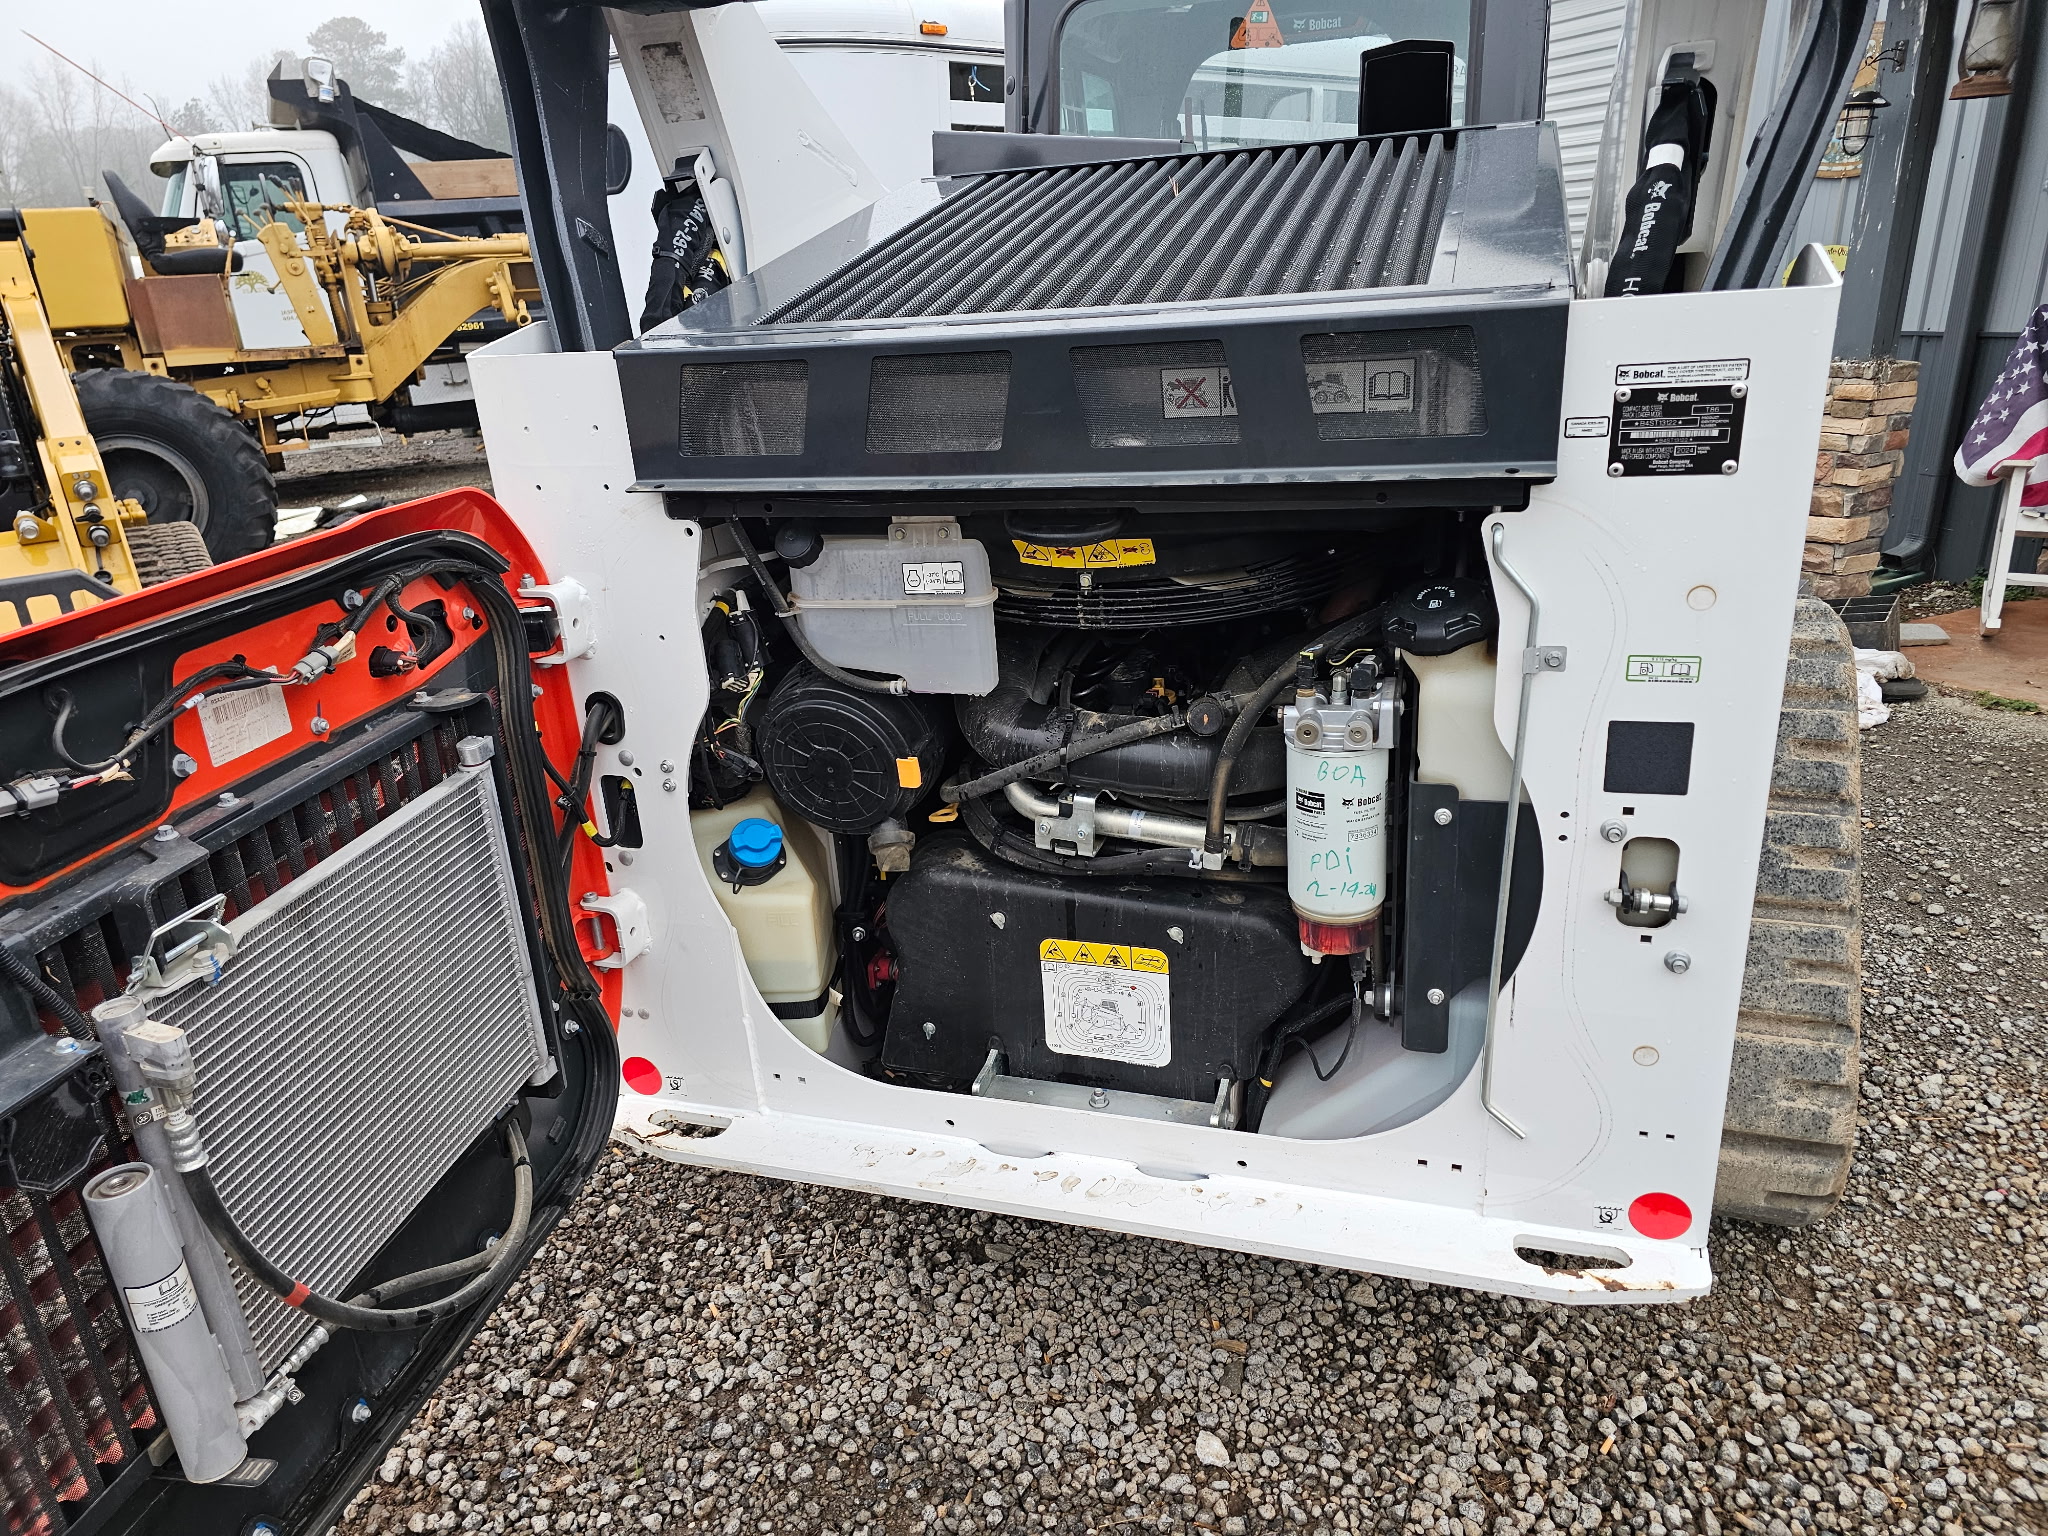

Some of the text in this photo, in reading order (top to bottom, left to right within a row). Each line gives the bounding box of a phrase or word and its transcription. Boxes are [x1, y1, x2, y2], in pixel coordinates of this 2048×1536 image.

[1308, 16, 1342, 31] Bobcat
[1633, 202, 1662, 254] Bobcat
[1633, 370, 1663, 379] Bobcat
[1670, 393, 1698, 402] Bobcat
[908, 612, 962, 620] FULL COLD
[1357, 792, 1382, 807] Bobcat
